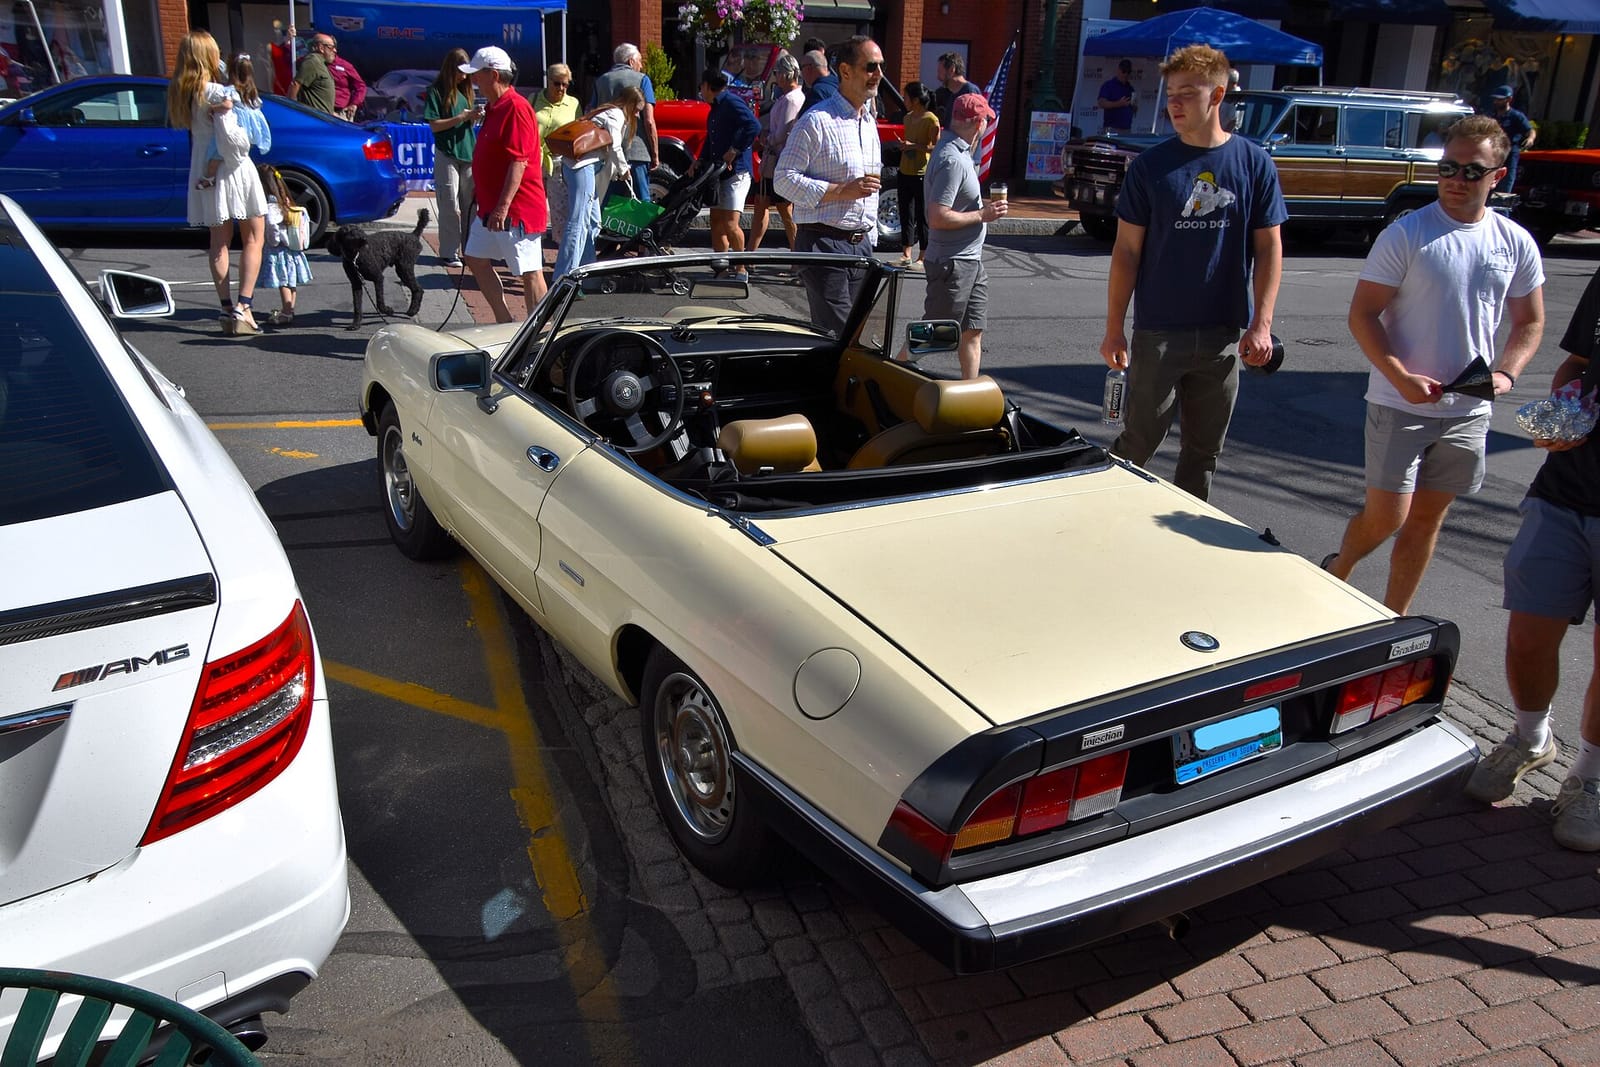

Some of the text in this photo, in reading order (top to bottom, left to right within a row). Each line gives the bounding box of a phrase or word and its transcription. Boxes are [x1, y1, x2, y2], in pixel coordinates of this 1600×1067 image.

[378, 27, 425, 40] GMC
[398, 143, 426, 165] CT
[1175, 220, 1230, 229] GOOD DOG
[1392, 639, 1429, 657] Graduate
[99, 643, 190, 681] AMG
[1083, 731, 1122, 747] injection
